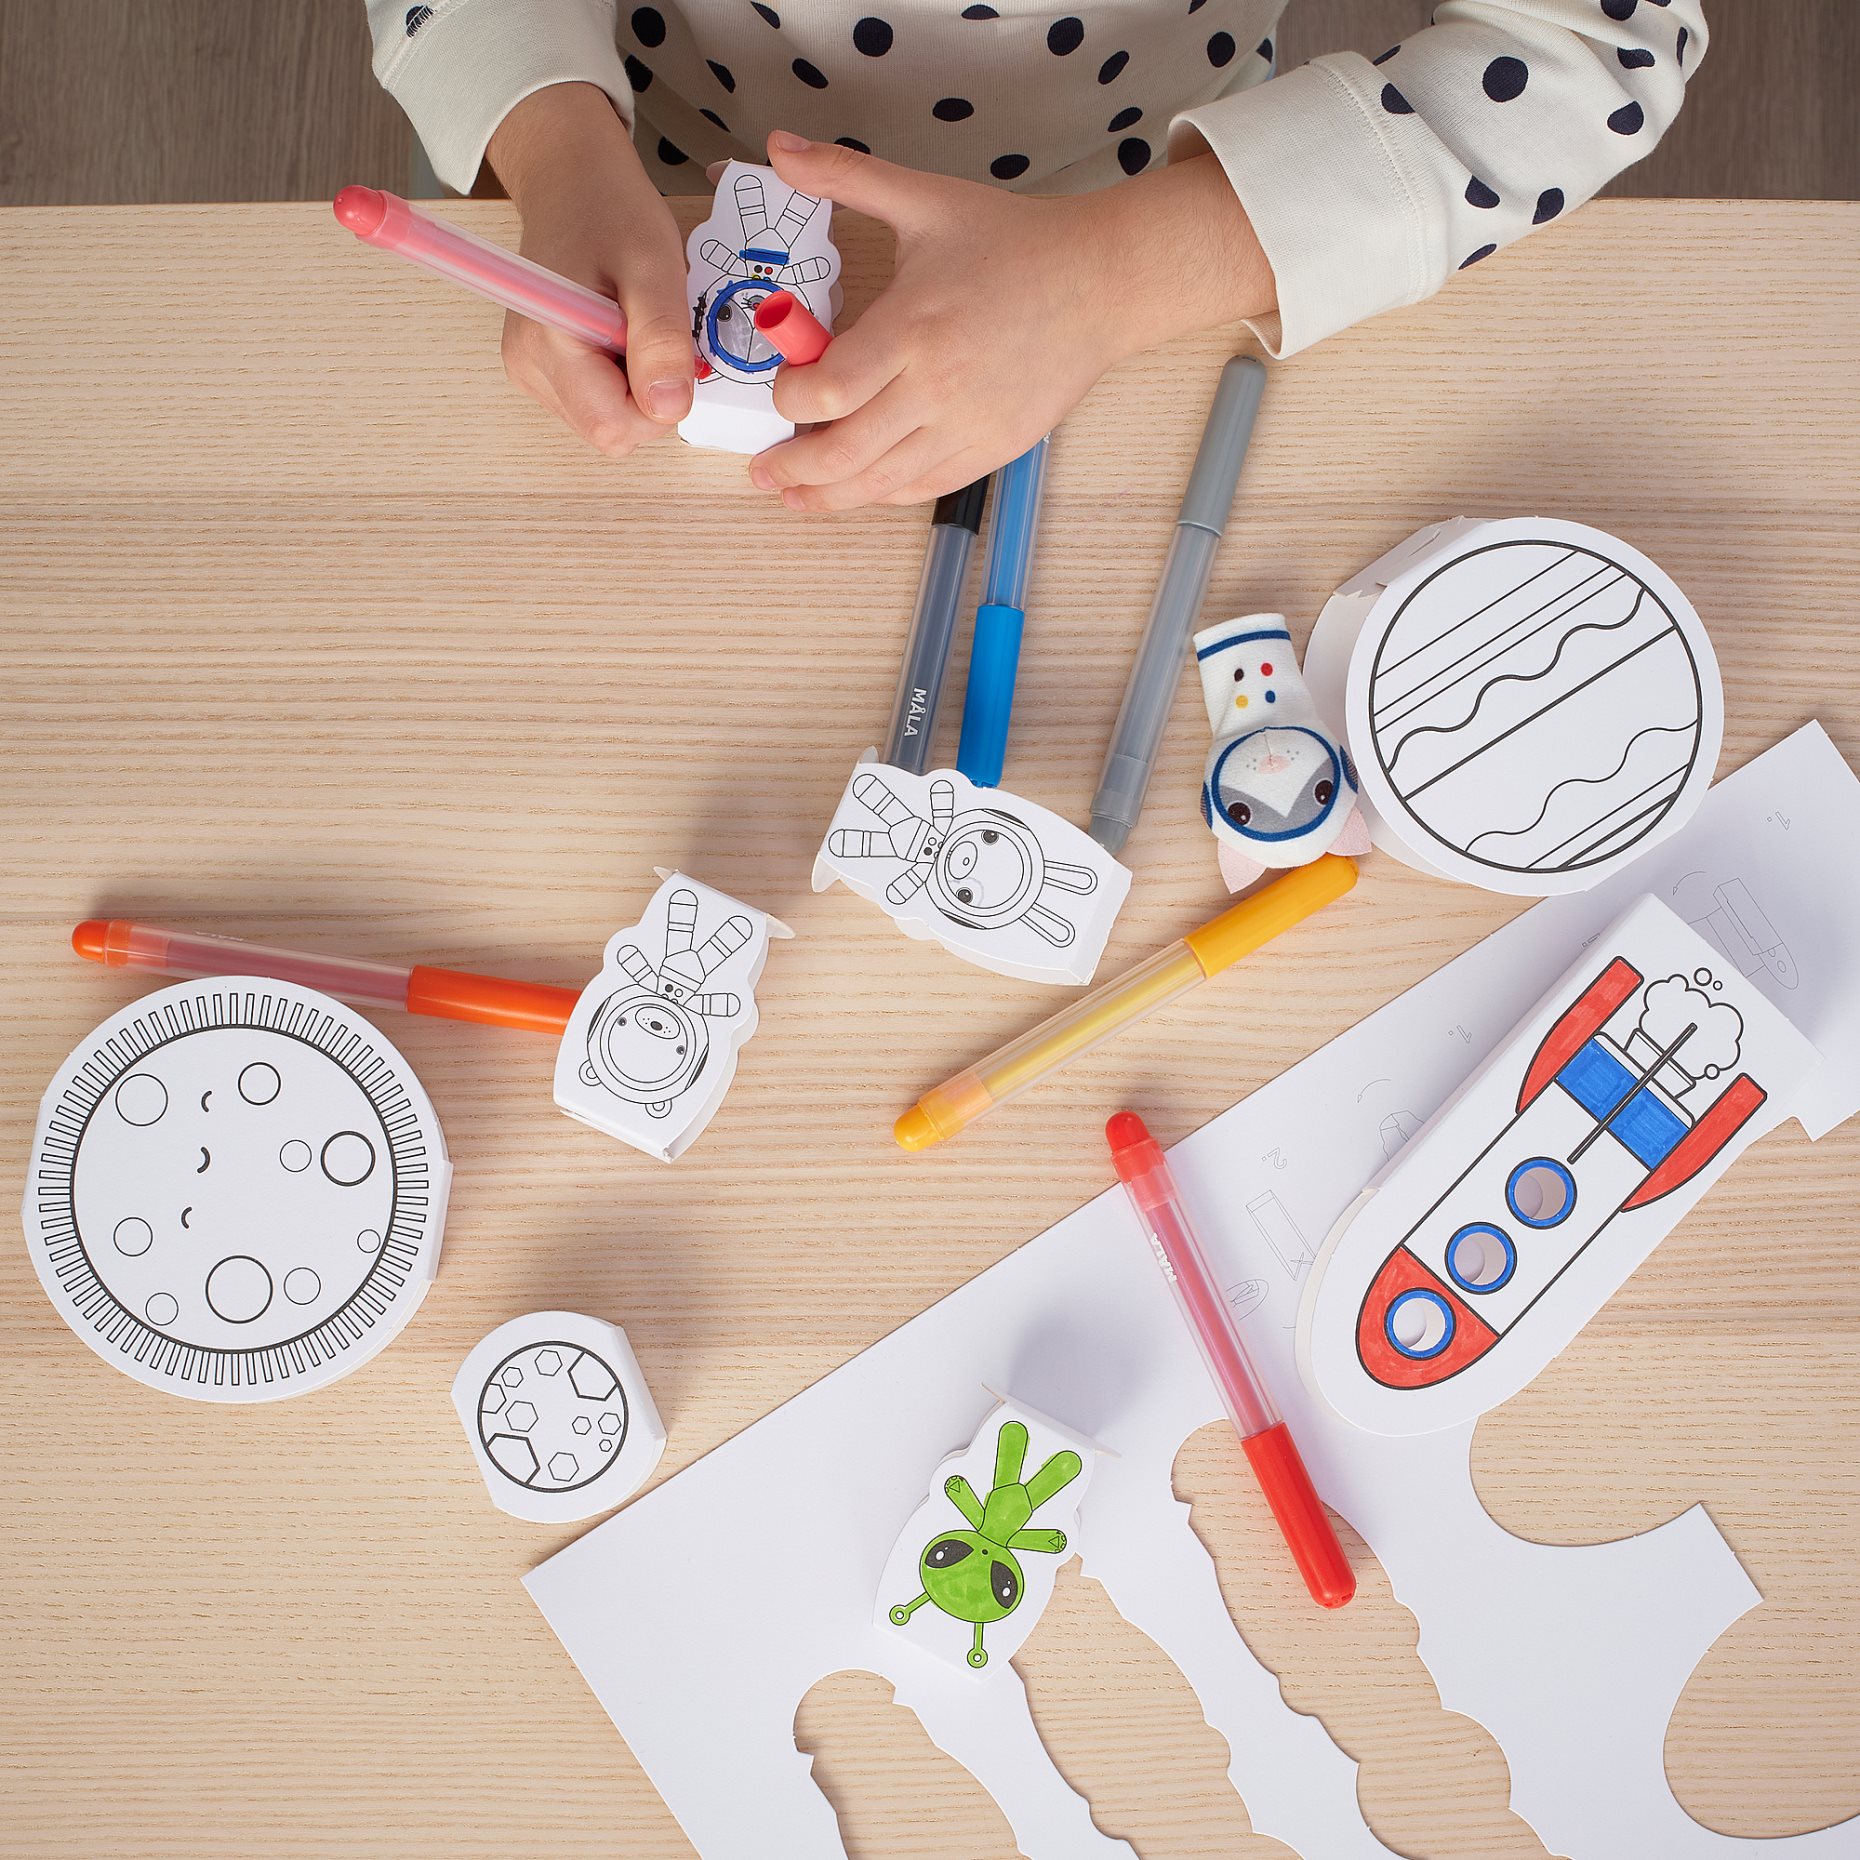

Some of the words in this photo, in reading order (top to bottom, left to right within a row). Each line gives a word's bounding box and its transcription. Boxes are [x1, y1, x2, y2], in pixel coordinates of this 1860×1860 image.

[904, 687, 927, 737] MÅLA
[1766, 811, 1791, 831] 1.
[1448, 1024, 1473, 1044] 1.
[1261, 1147, 1288, 1170] 2.
